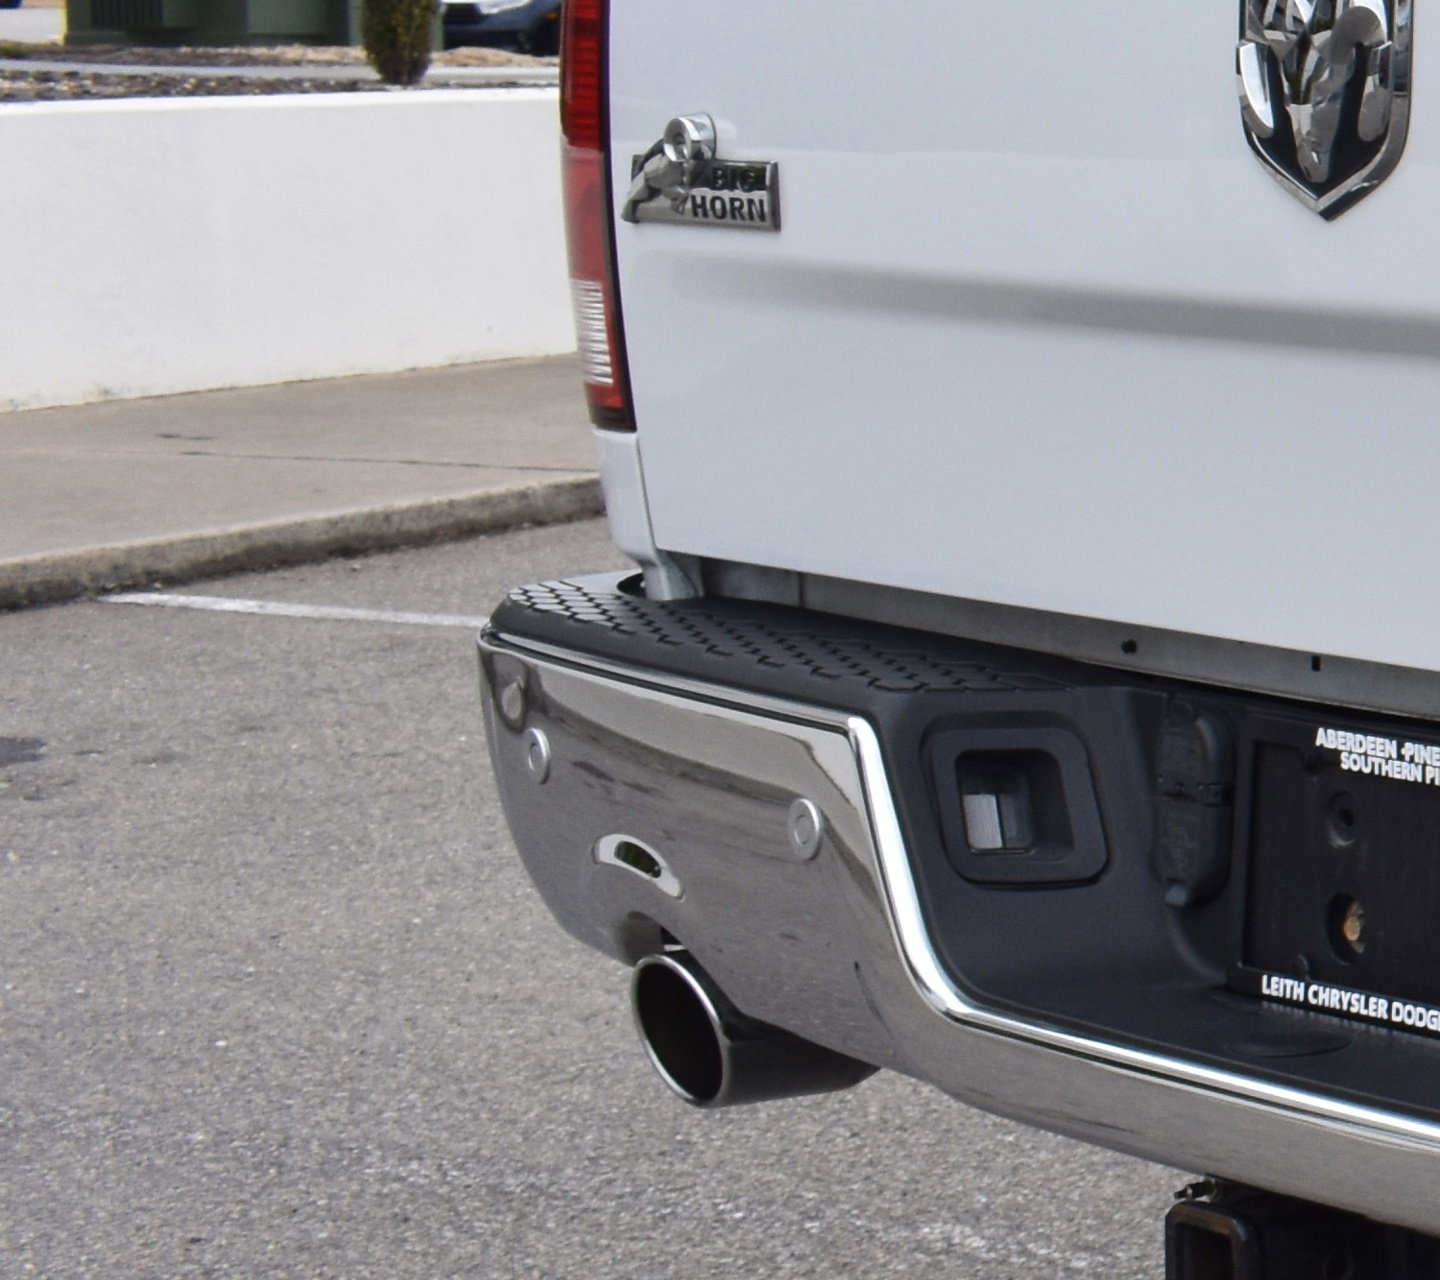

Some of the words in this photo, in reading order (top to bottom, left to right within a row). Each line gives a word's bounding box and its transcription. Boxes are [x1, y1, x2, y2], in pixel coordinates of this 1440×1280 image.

[691, 195, 767, 222] HORN
[1314, 727, 1398, 760] ABERDEEN
[1340, 751, 1423, 784] SOUTHERN
[1261, 974, 1305, 1002] LEITH
[1307, 983, 1388, 1020] CHRYSLER
